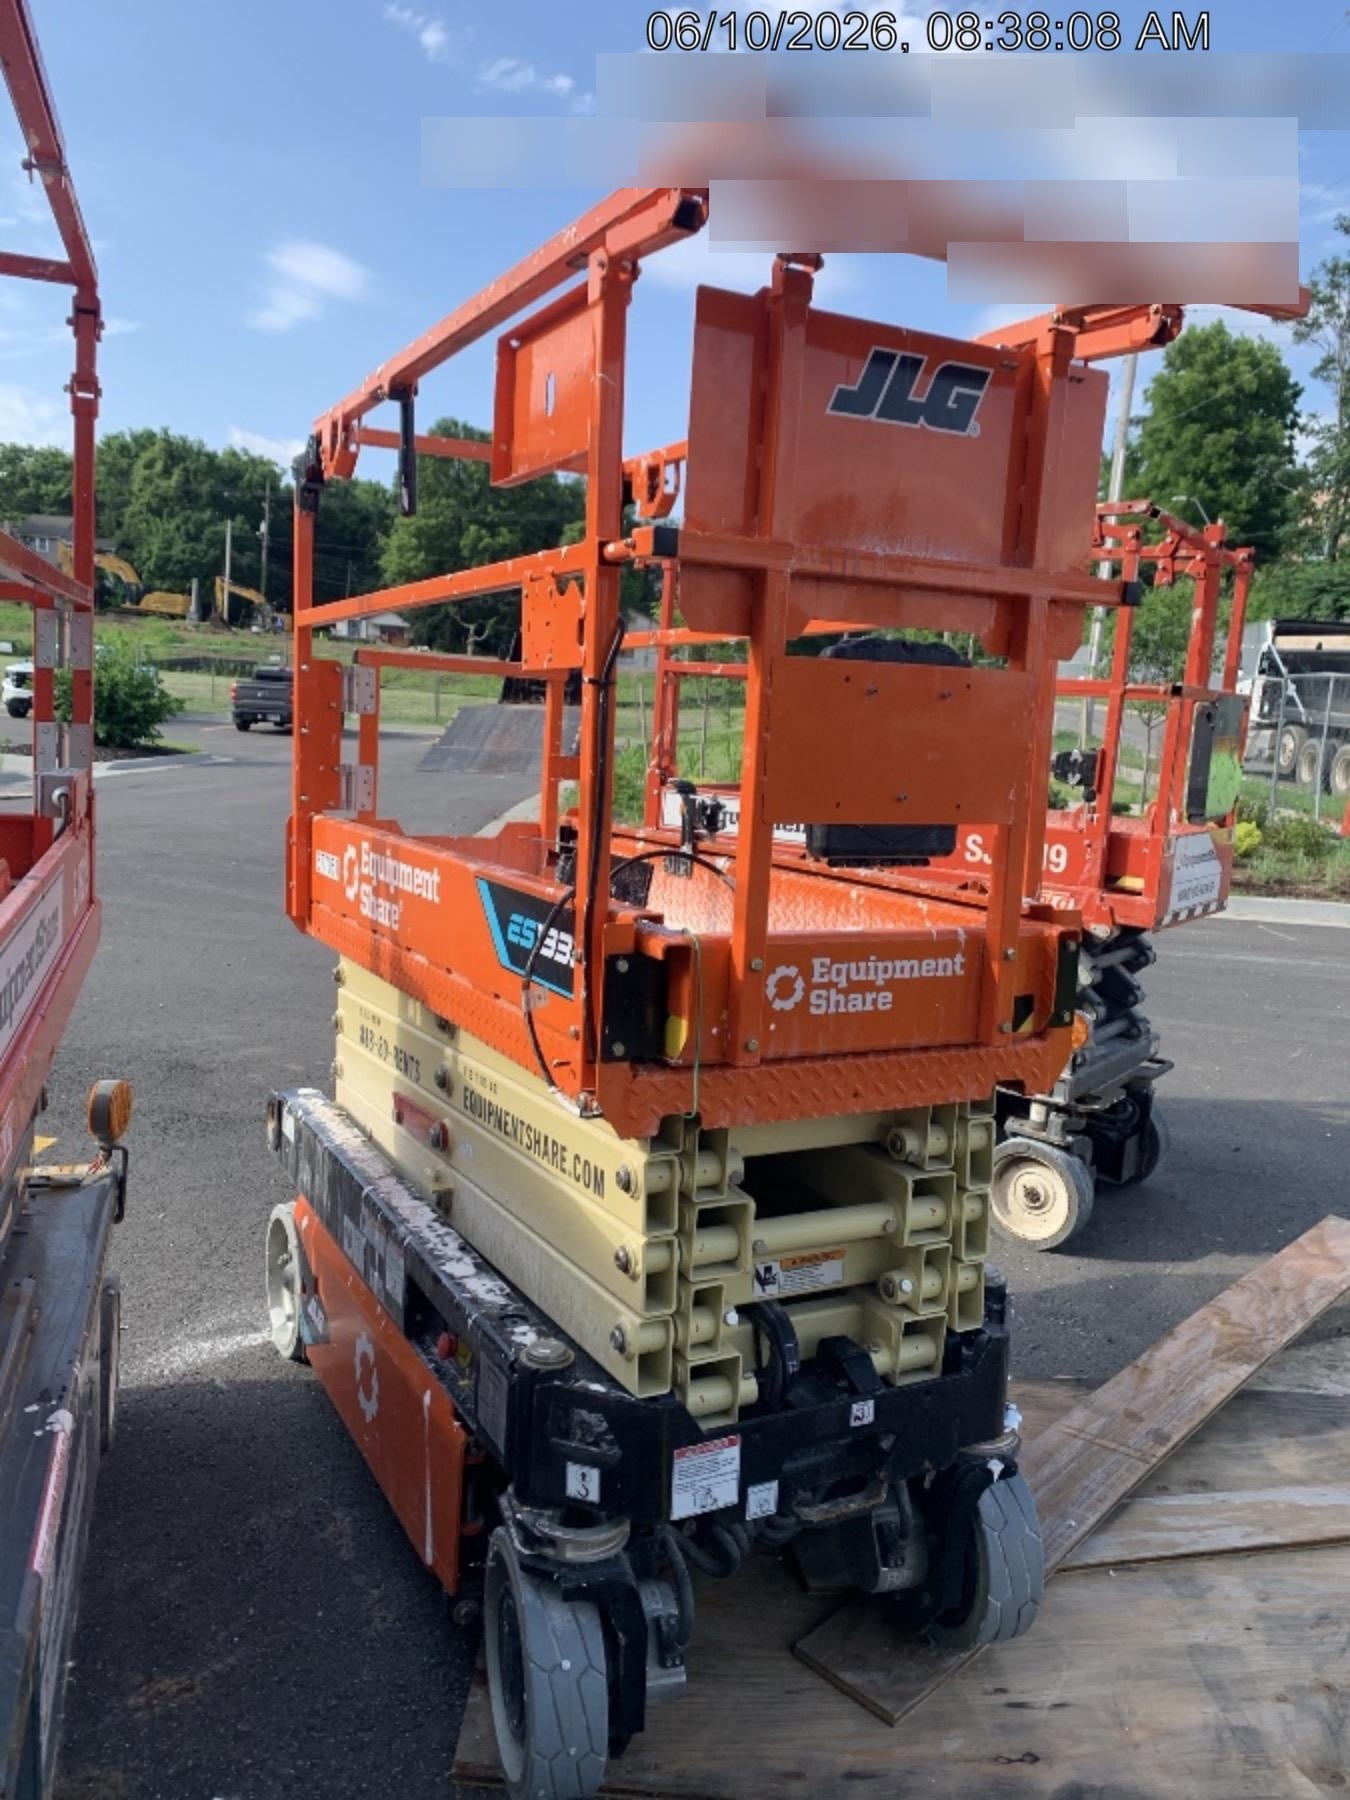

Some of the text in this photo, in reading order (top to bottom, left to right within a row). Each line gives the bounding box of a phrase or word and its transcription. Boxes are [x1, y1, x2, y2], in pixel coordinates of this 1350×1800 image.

[826, 346, 993, 436] JLG
[361, 841, 441, 904] Equipment
[360, 882, 399, 931] Share
[507, 913, 575, 968] ES33
[811, 953, 965, 988] Equipment
[809, 988, 893, 1015] Share
[463, 1085, 605, 1199] EQUIPMENTSHARE.COM
